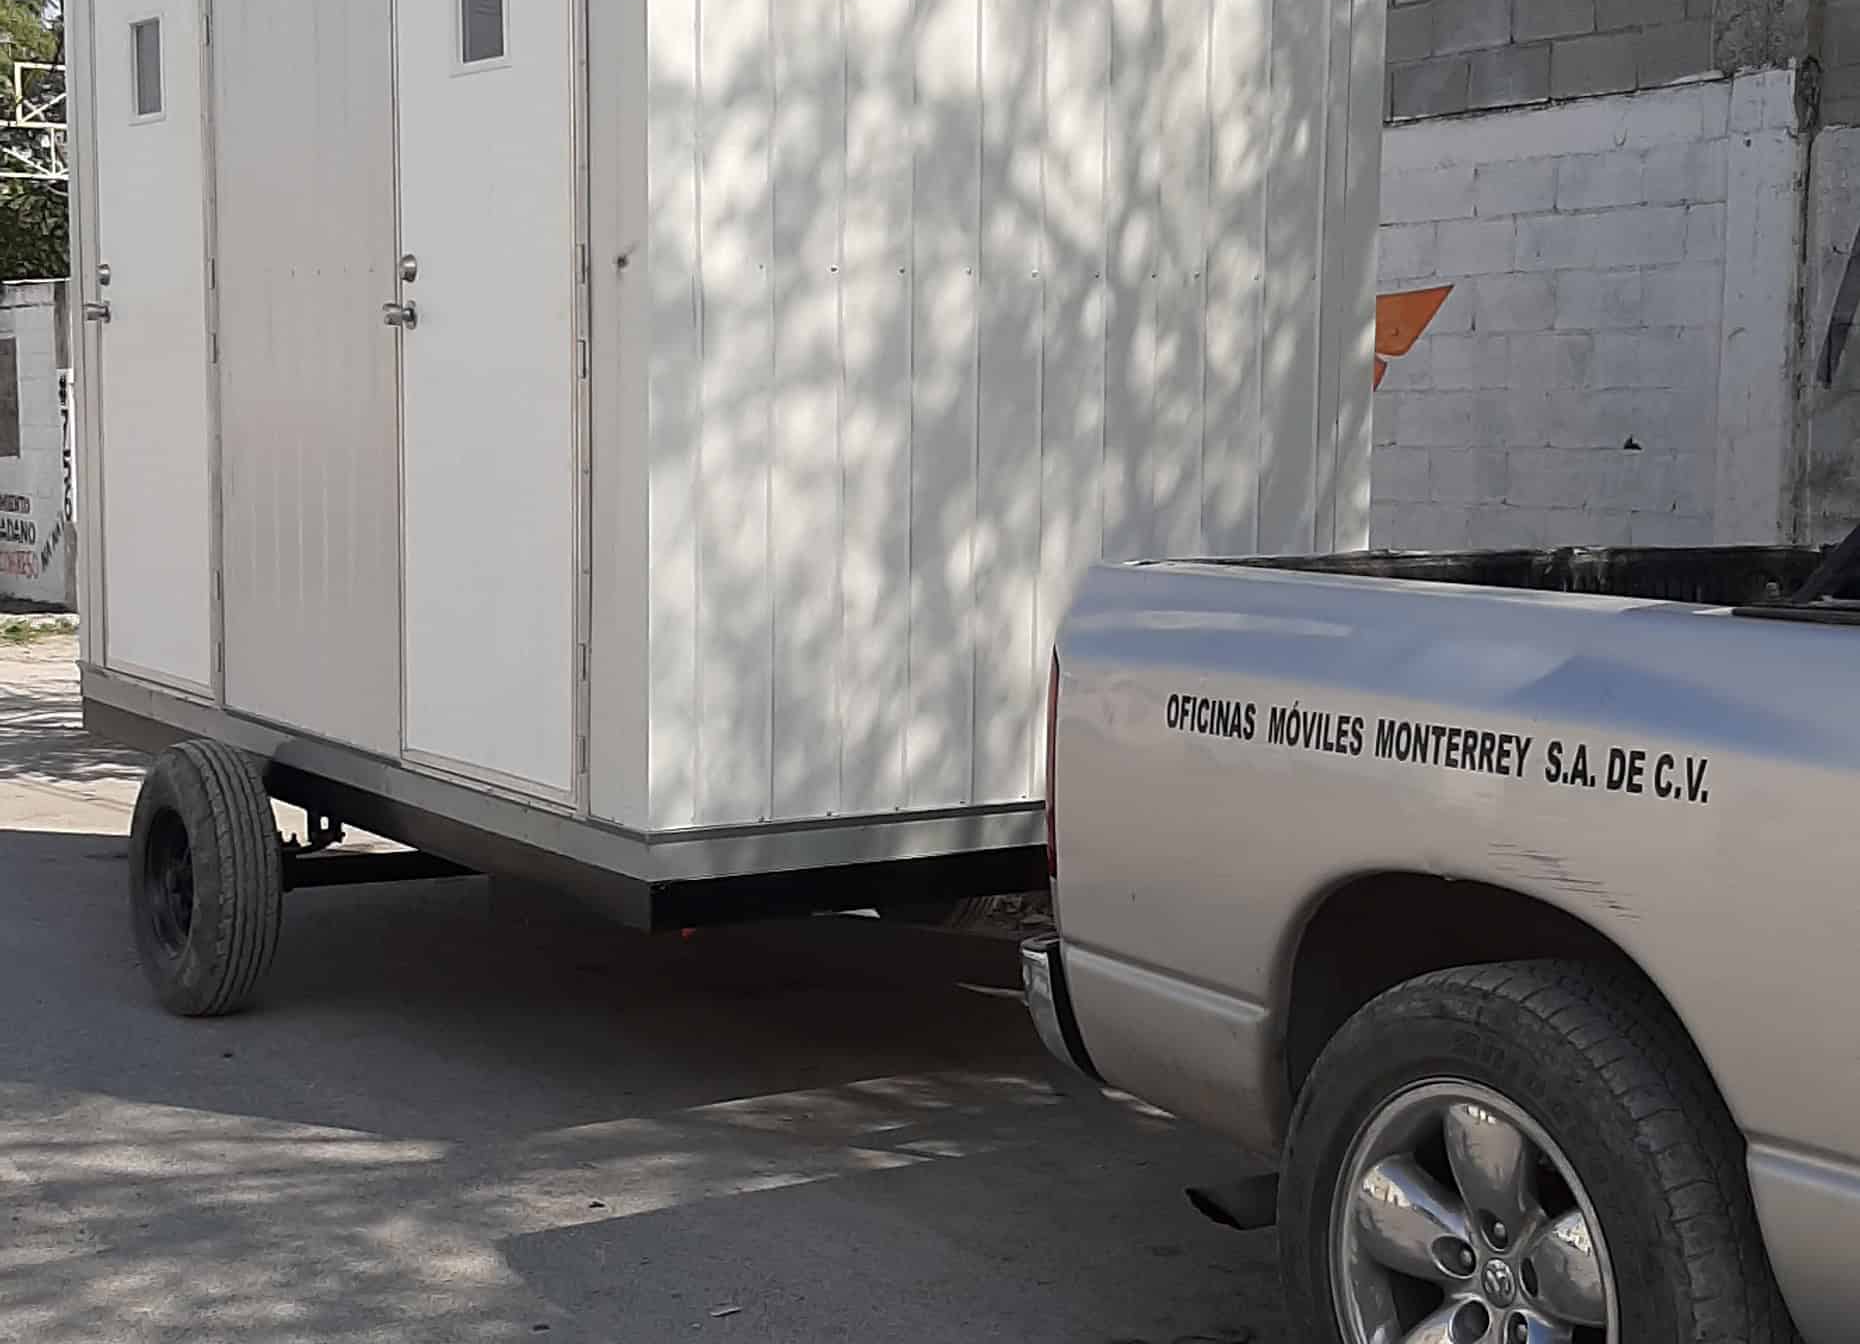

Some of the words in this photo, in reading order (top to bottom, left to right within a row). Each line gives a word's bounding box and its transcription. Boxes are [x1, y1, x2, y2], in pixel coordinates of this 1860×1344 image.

[1167, 693, 1257, 741] OFICINAS
[1268, 700, 1364, 756] MÓVILES
[1375, 718, 1532, 778] MONTERREY
[1545, 741, 1596, 788] S.A.
[1606, 748, 1646, 794] DE
[1654, 753, 1708, 804] C.V.
